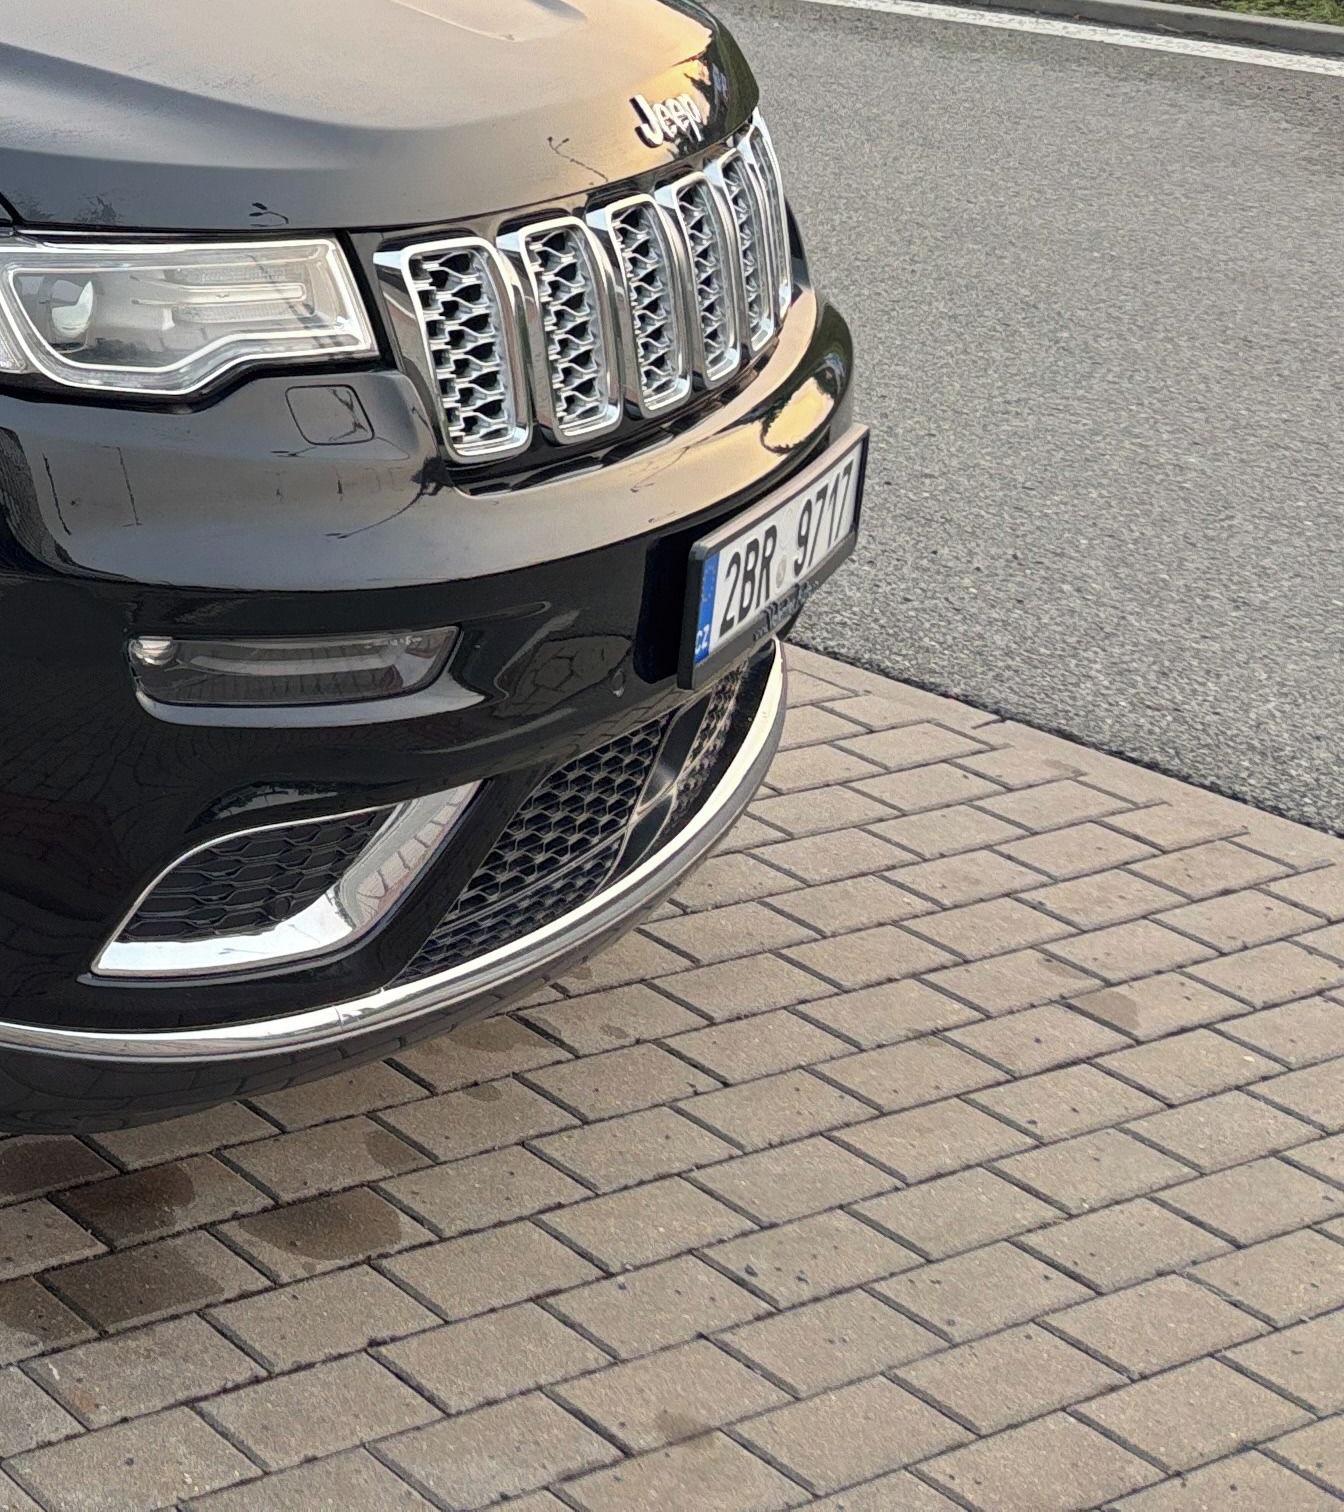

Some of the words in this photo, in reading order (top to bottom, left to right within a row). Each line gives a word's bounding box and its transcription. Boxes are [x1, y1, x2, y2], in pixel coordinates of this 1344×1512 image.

[628, 93, 703, 149] Jeep
[719, 523, 778, 639] 2BR
[793, 458, 855, 578] 9717
[695, 623, 710, 655] CZ
